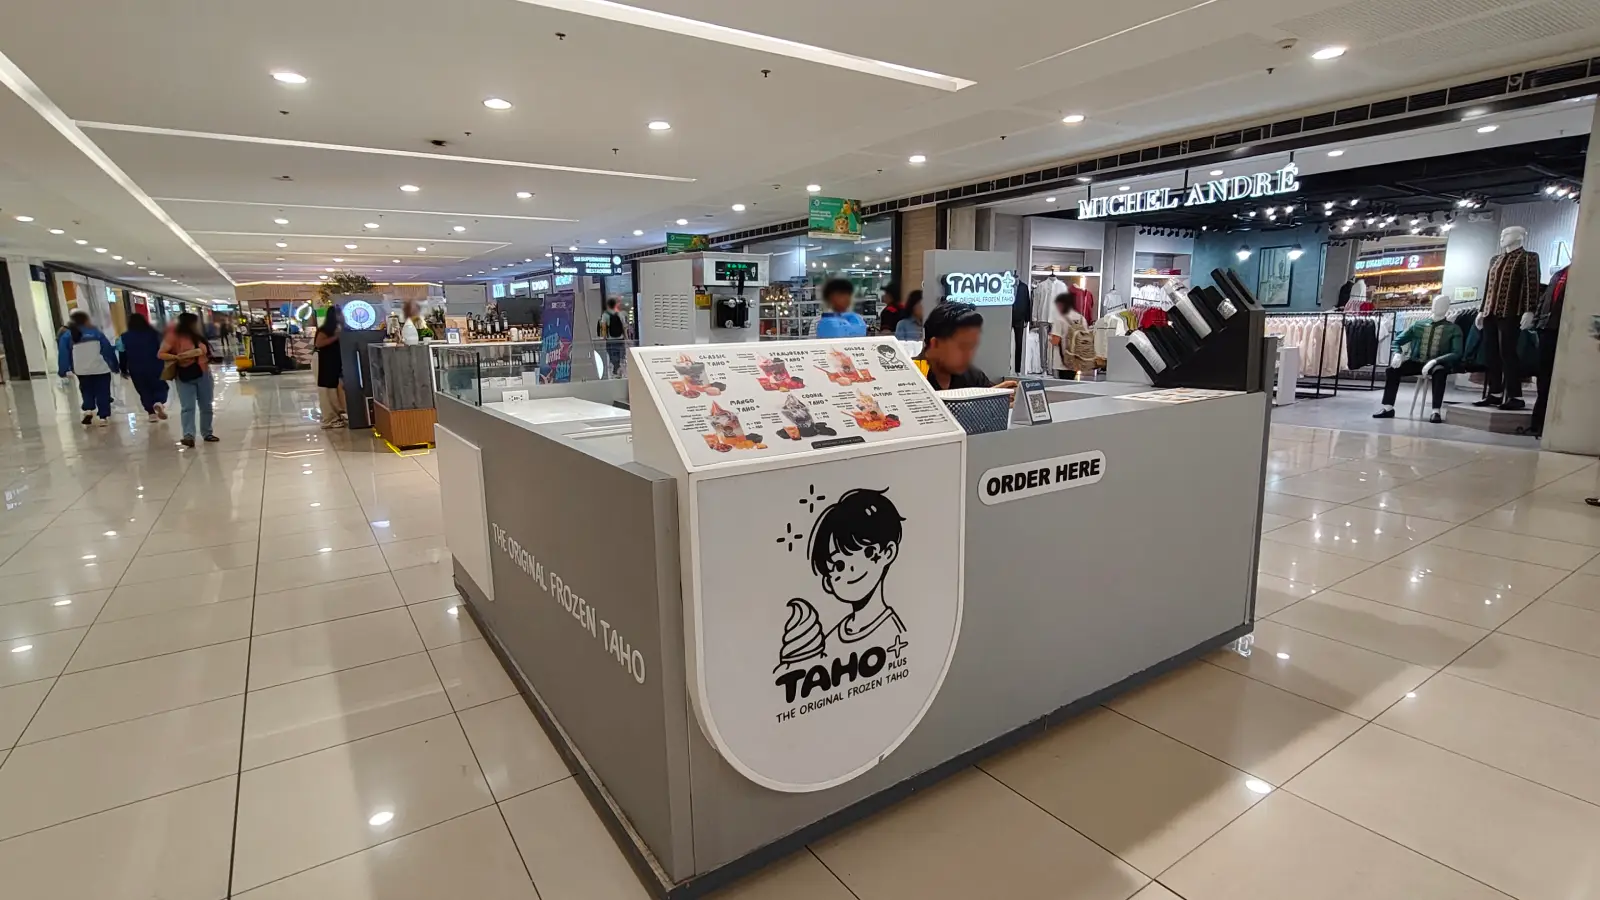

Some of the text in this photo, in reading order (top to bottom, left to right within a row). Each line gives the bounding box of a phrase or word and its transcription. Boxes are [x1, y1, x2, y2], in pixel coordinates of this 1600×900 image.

[1077, 162, 1299, 219] MICHEL ANDRÉ
[950, 276, 1002, 294] TAHO
[987, 458, 1101, 496] ORDER HERE
[492, 523, 646, 684] THE ORIGINAL FROZEN TAHO
[775, 646, 887, 704] TAHO
[888, 658, 907, 671] PLUS
[776, 669, 909, 723] THE ORIGINAL FROZEN TAHO
